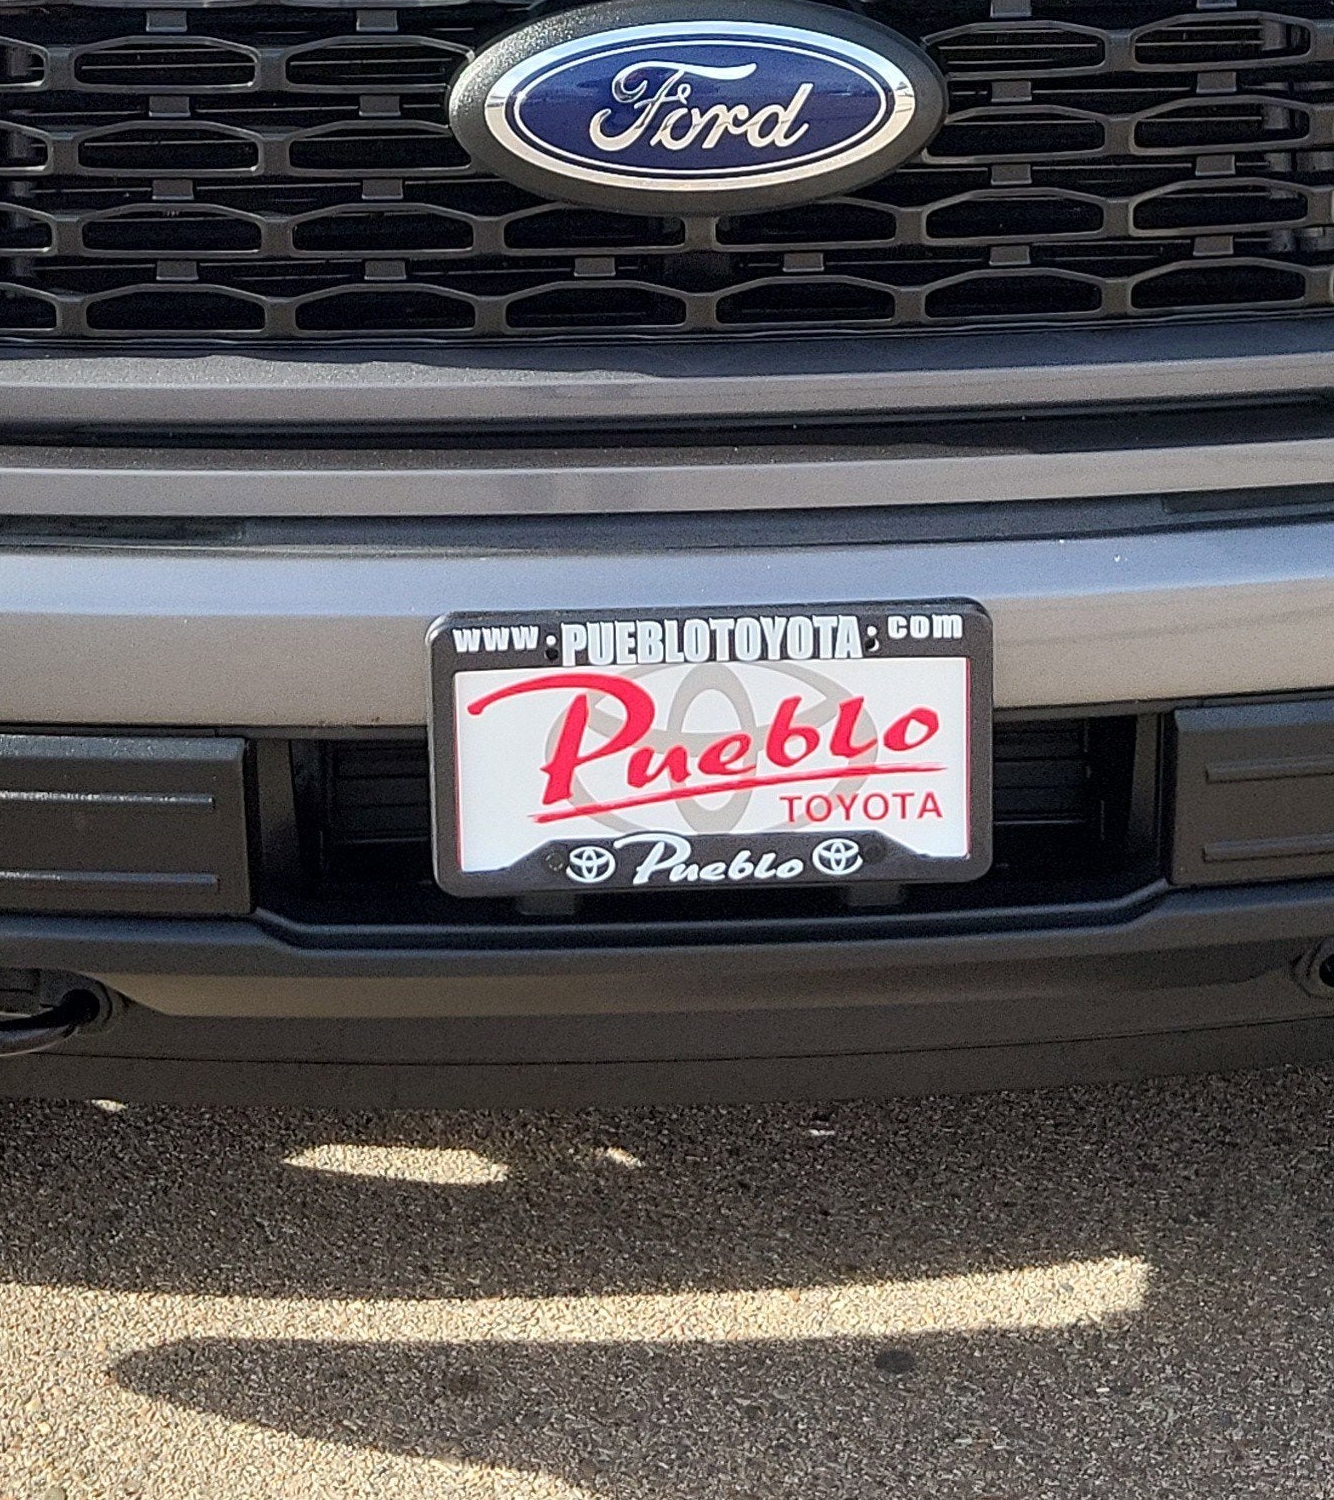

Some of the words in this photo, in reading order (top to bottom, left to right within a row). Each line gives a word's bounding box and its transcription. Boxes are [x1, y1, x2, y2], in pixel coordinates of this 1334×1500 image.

[589, 60, 814, 152] Ford
[467, 672, 940, 805] Pueblo
[779, 791, 944, 824] TOYOTA
[613, 833, 804, 886] Pueblo
